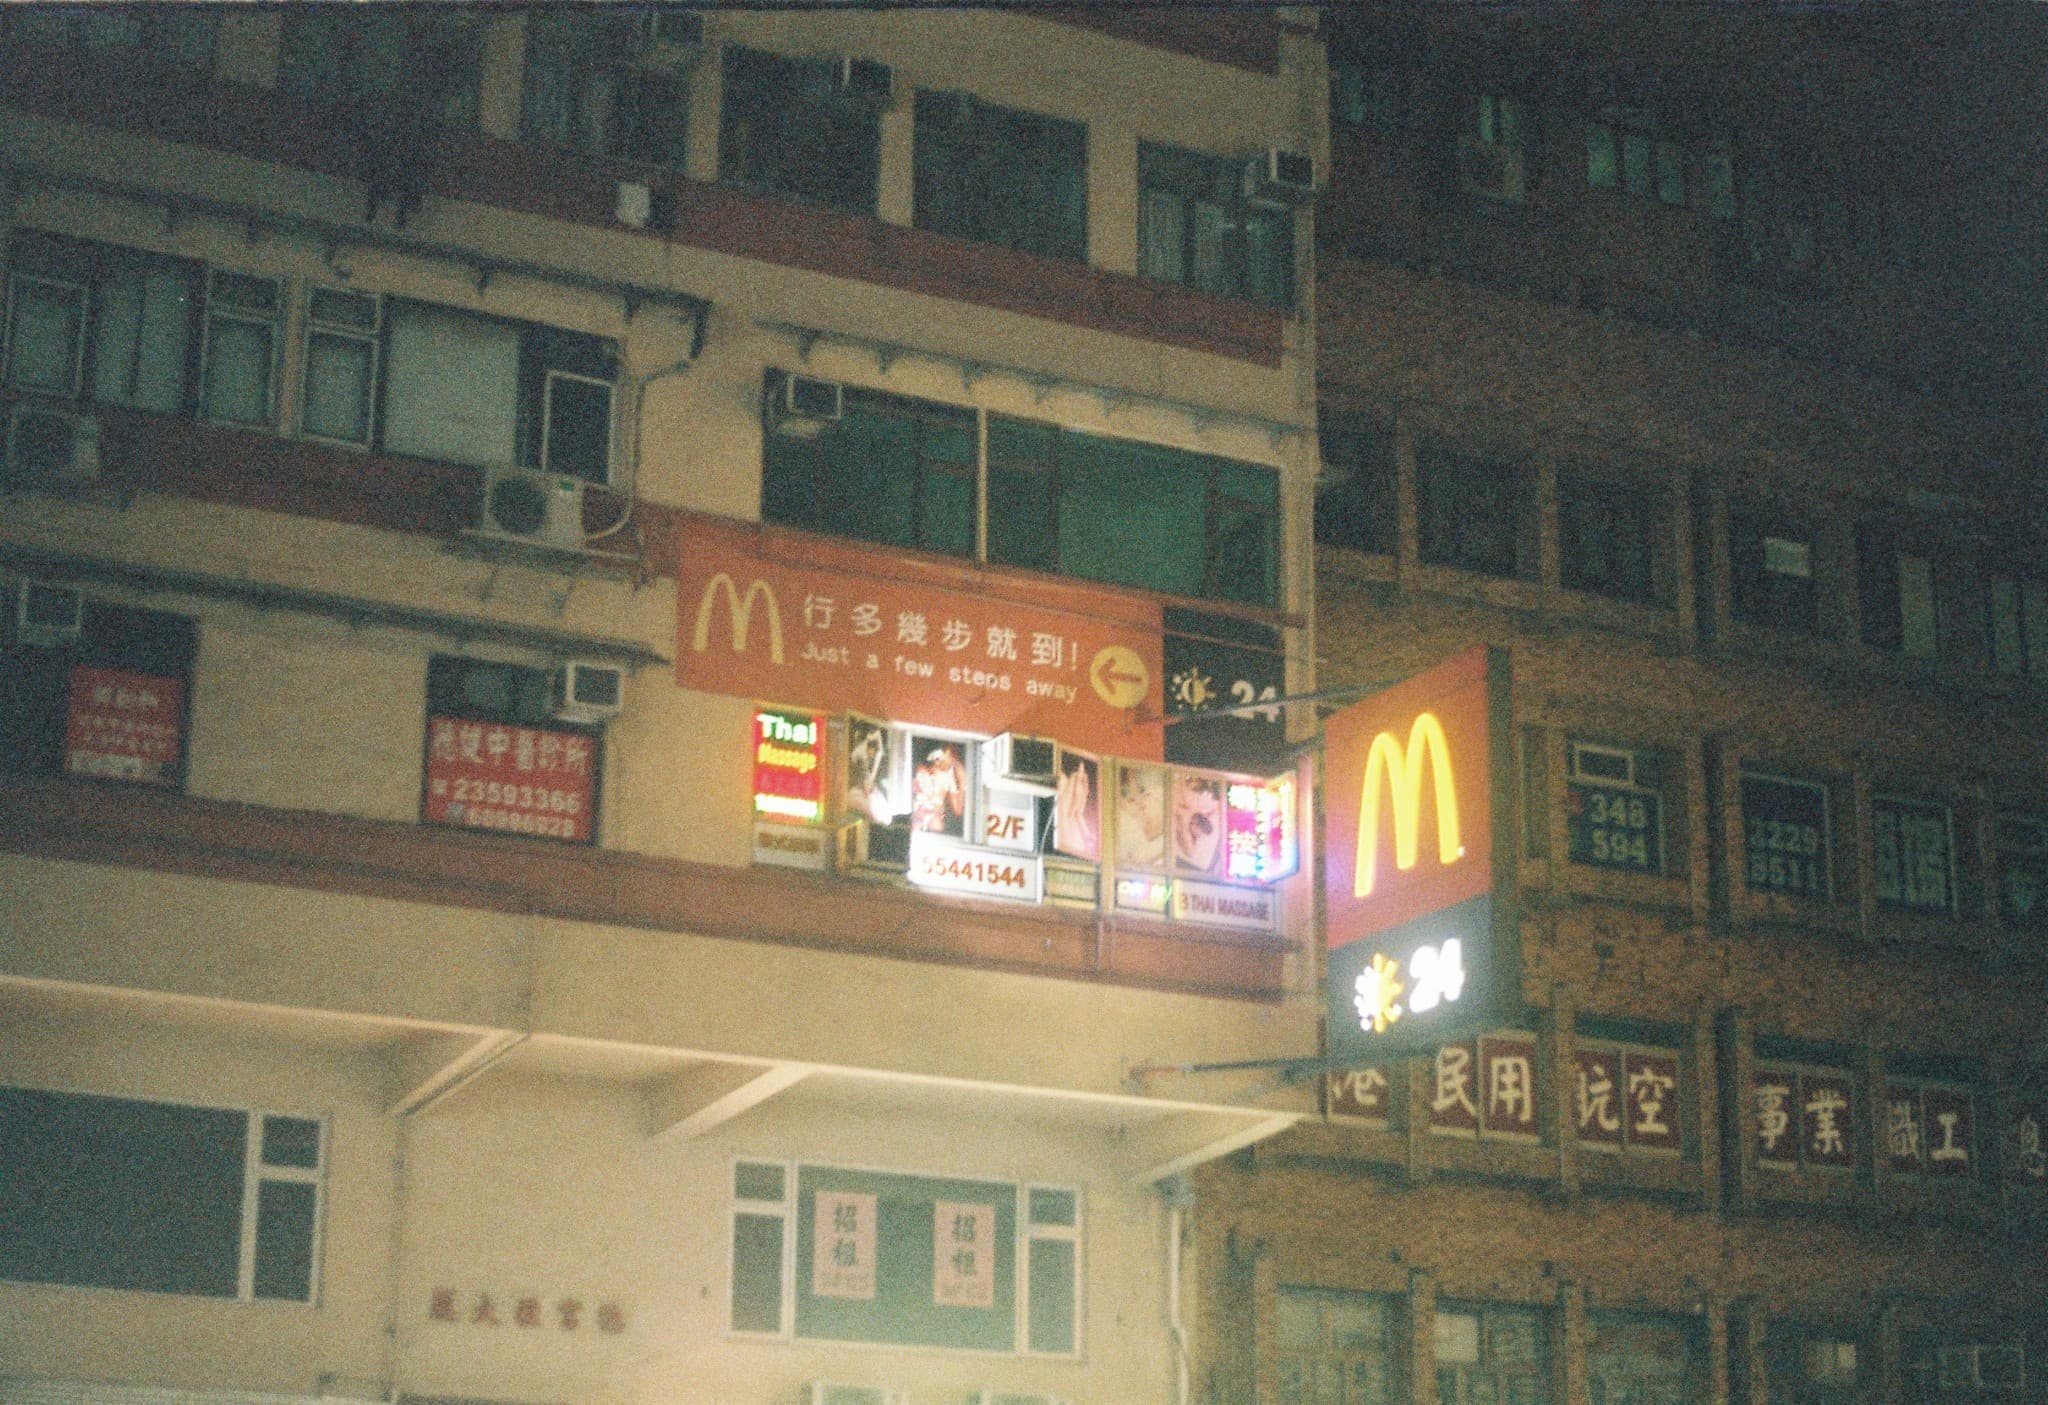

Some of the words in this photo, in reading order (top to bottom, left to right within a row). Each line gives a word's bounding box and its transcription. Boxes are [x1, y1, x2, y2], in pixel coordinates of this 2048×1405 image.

[804, 595, 1078, 671] 行多幾步就到!
[802, 641, 849, 665] Just
[866, 652, 879, 669] a
[895, 654, 935, 678] few
[1025, 679, 1078, 704] away
[1230, 679, 1280, 723] 24
[987, 814, 1025, 839] 2/F
[1408, 937, 1465, 1014] 24
